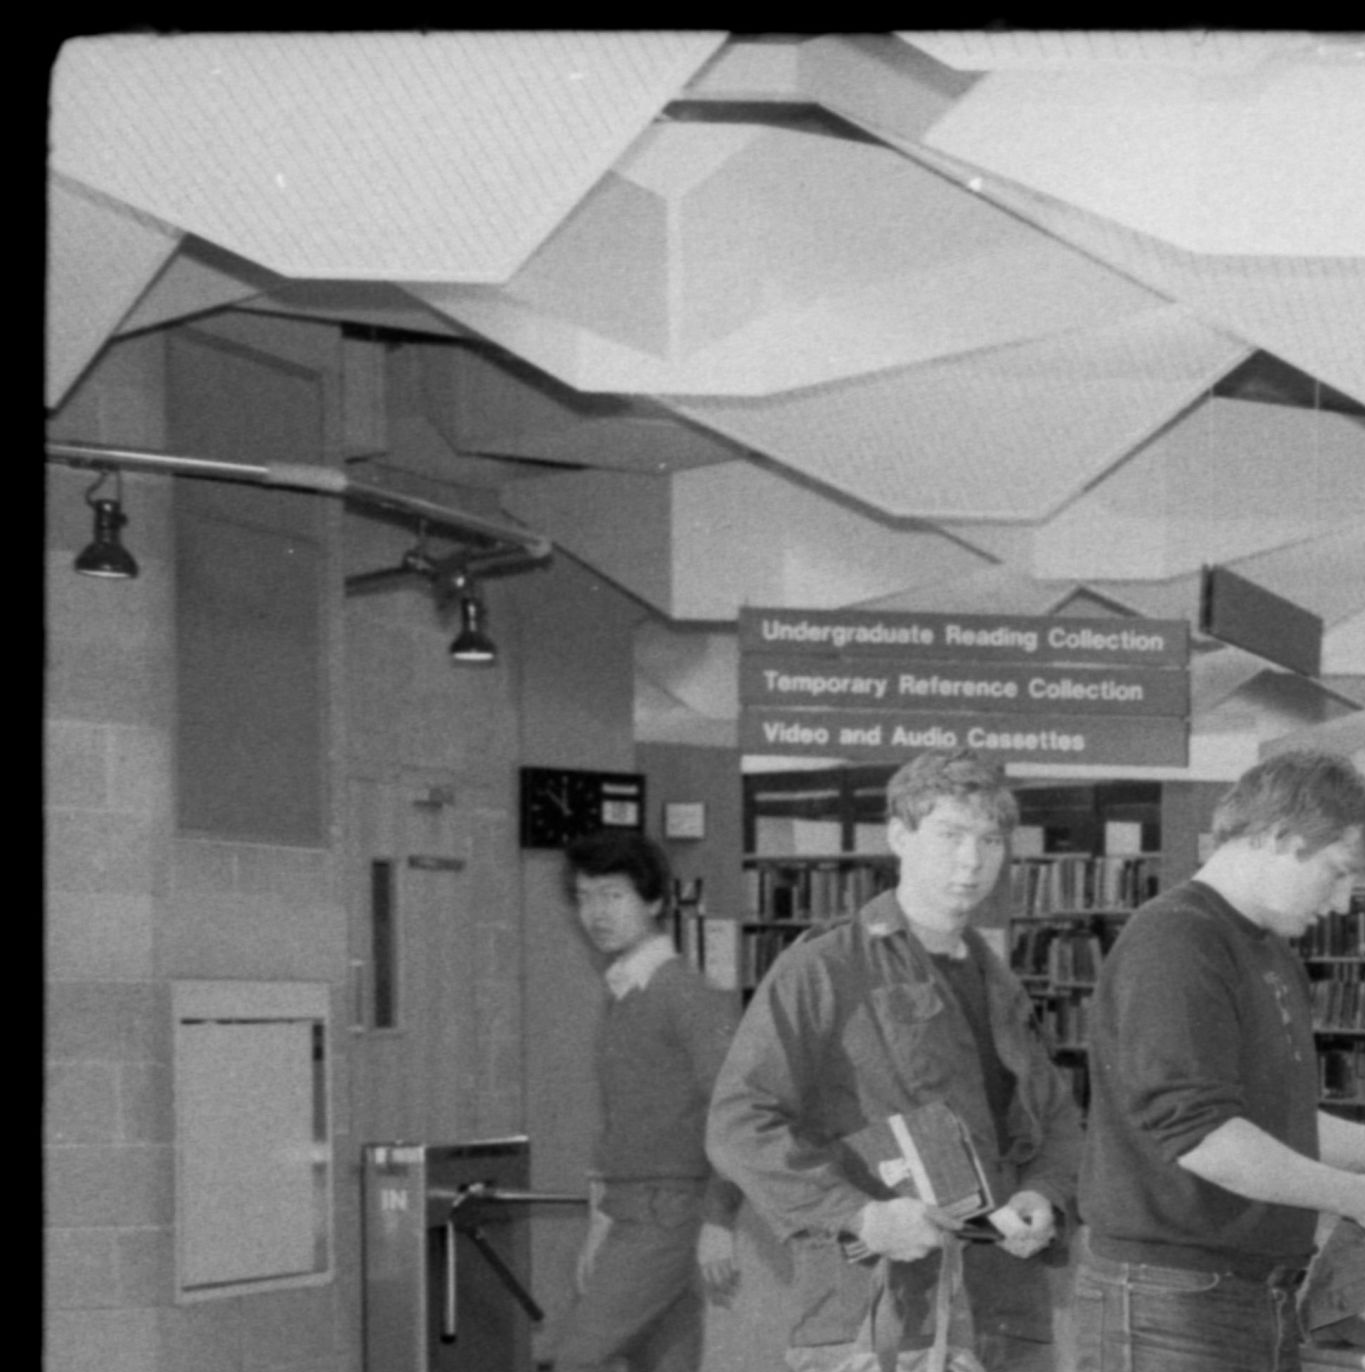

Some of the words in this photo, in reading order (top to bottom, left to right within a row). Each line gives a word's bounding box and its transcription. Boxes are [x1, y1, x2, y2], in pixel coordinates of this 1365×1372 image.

[761, 619, 935, 649] Undergraduate
[945, 624, 1038, 652] Reading
[1047, 628, 1166, 652] Collection
[762, 670, 888, 699] Temporary
[899, 674, 1020, 699] Reference
[1028, 676, 1145, 701] Collection
[762, 721, 830, 746] Video
[839, 724, 882, 745] and
[891, 725, 958, 748] Audio
[966, 726, 1086, 751] Cassettes
[381, 1189, 408, 1211] IN
